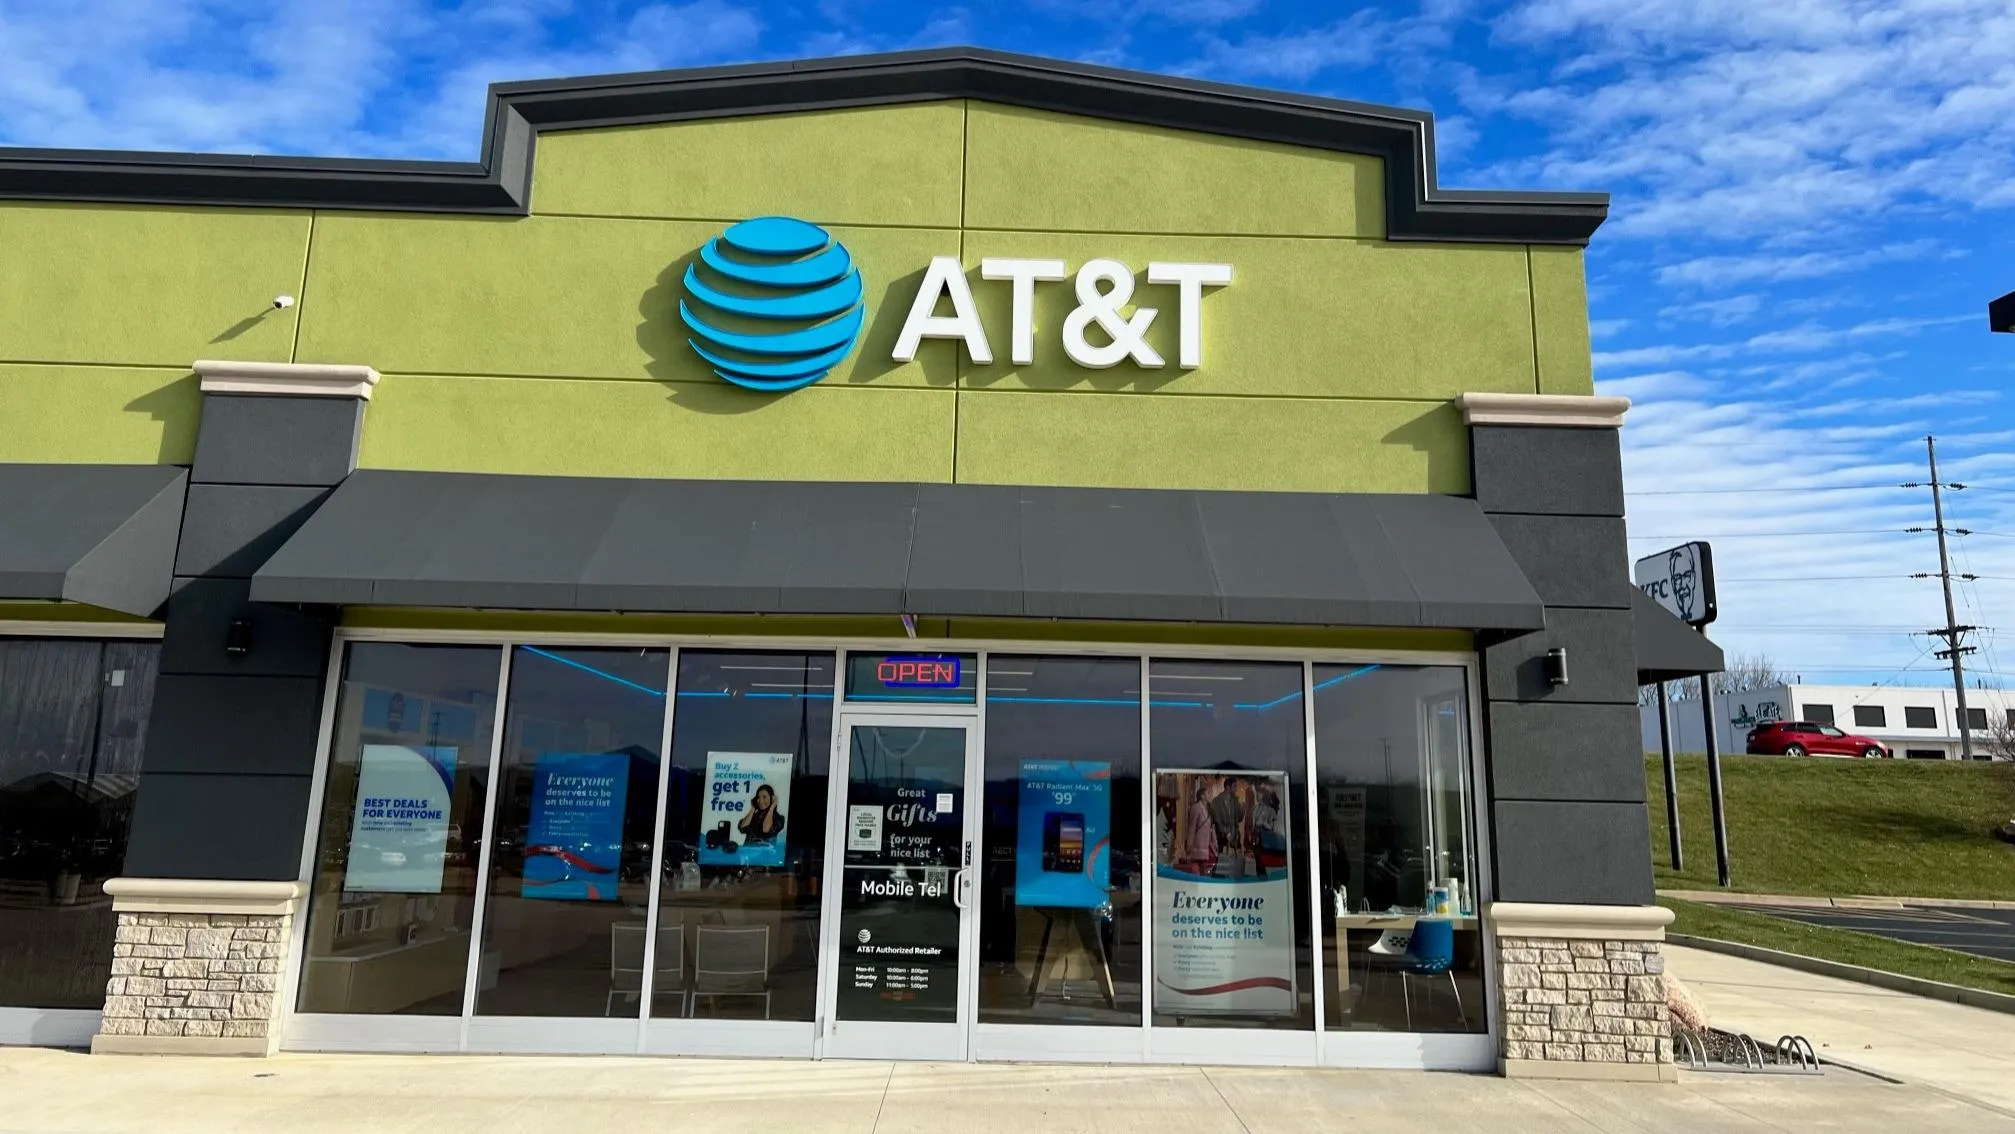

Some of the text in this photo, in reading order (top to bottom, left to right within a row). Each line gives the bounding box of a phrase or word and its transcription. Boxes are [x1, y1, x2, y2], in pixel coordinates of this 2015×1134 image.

[892, 256, 1233, 369] AT&T
[877, 662, 953, 682] OPEN
[715, 762, 739, 771] Buy 2
[547, 773, 615, 789] Everyone
[714, 771, 766, 780] accessories,
[546, 788, 611, 797] deserves to be
[712, 780, 751, 796] get 1
[897, 788, 926, 798] Great
[364, 798, 428, 809] BEST DEALS
[559, 798, 574, 806] the
[576, 798, 594, 807] nice
[596, 798, 611, 807] list
[362, 809, 442, 820] FOR EVERYONE
[886, 803, 938, 827] Gifts
[890, 833, 932, 847] for your
[891, 848, 930, 859] nice list
[860, 880, 940, 897] Mobile Tel
[1172, 891, 1264, 914] Everyone
[1172, 913, 1263, 925] deserves to be
[1172, 928, 1264, 939] on the nice list
[876, 946, 914, 954] Authorized
[914, 947, 942, 955] Retailer
[854, 981, 873, 989] Sunday
